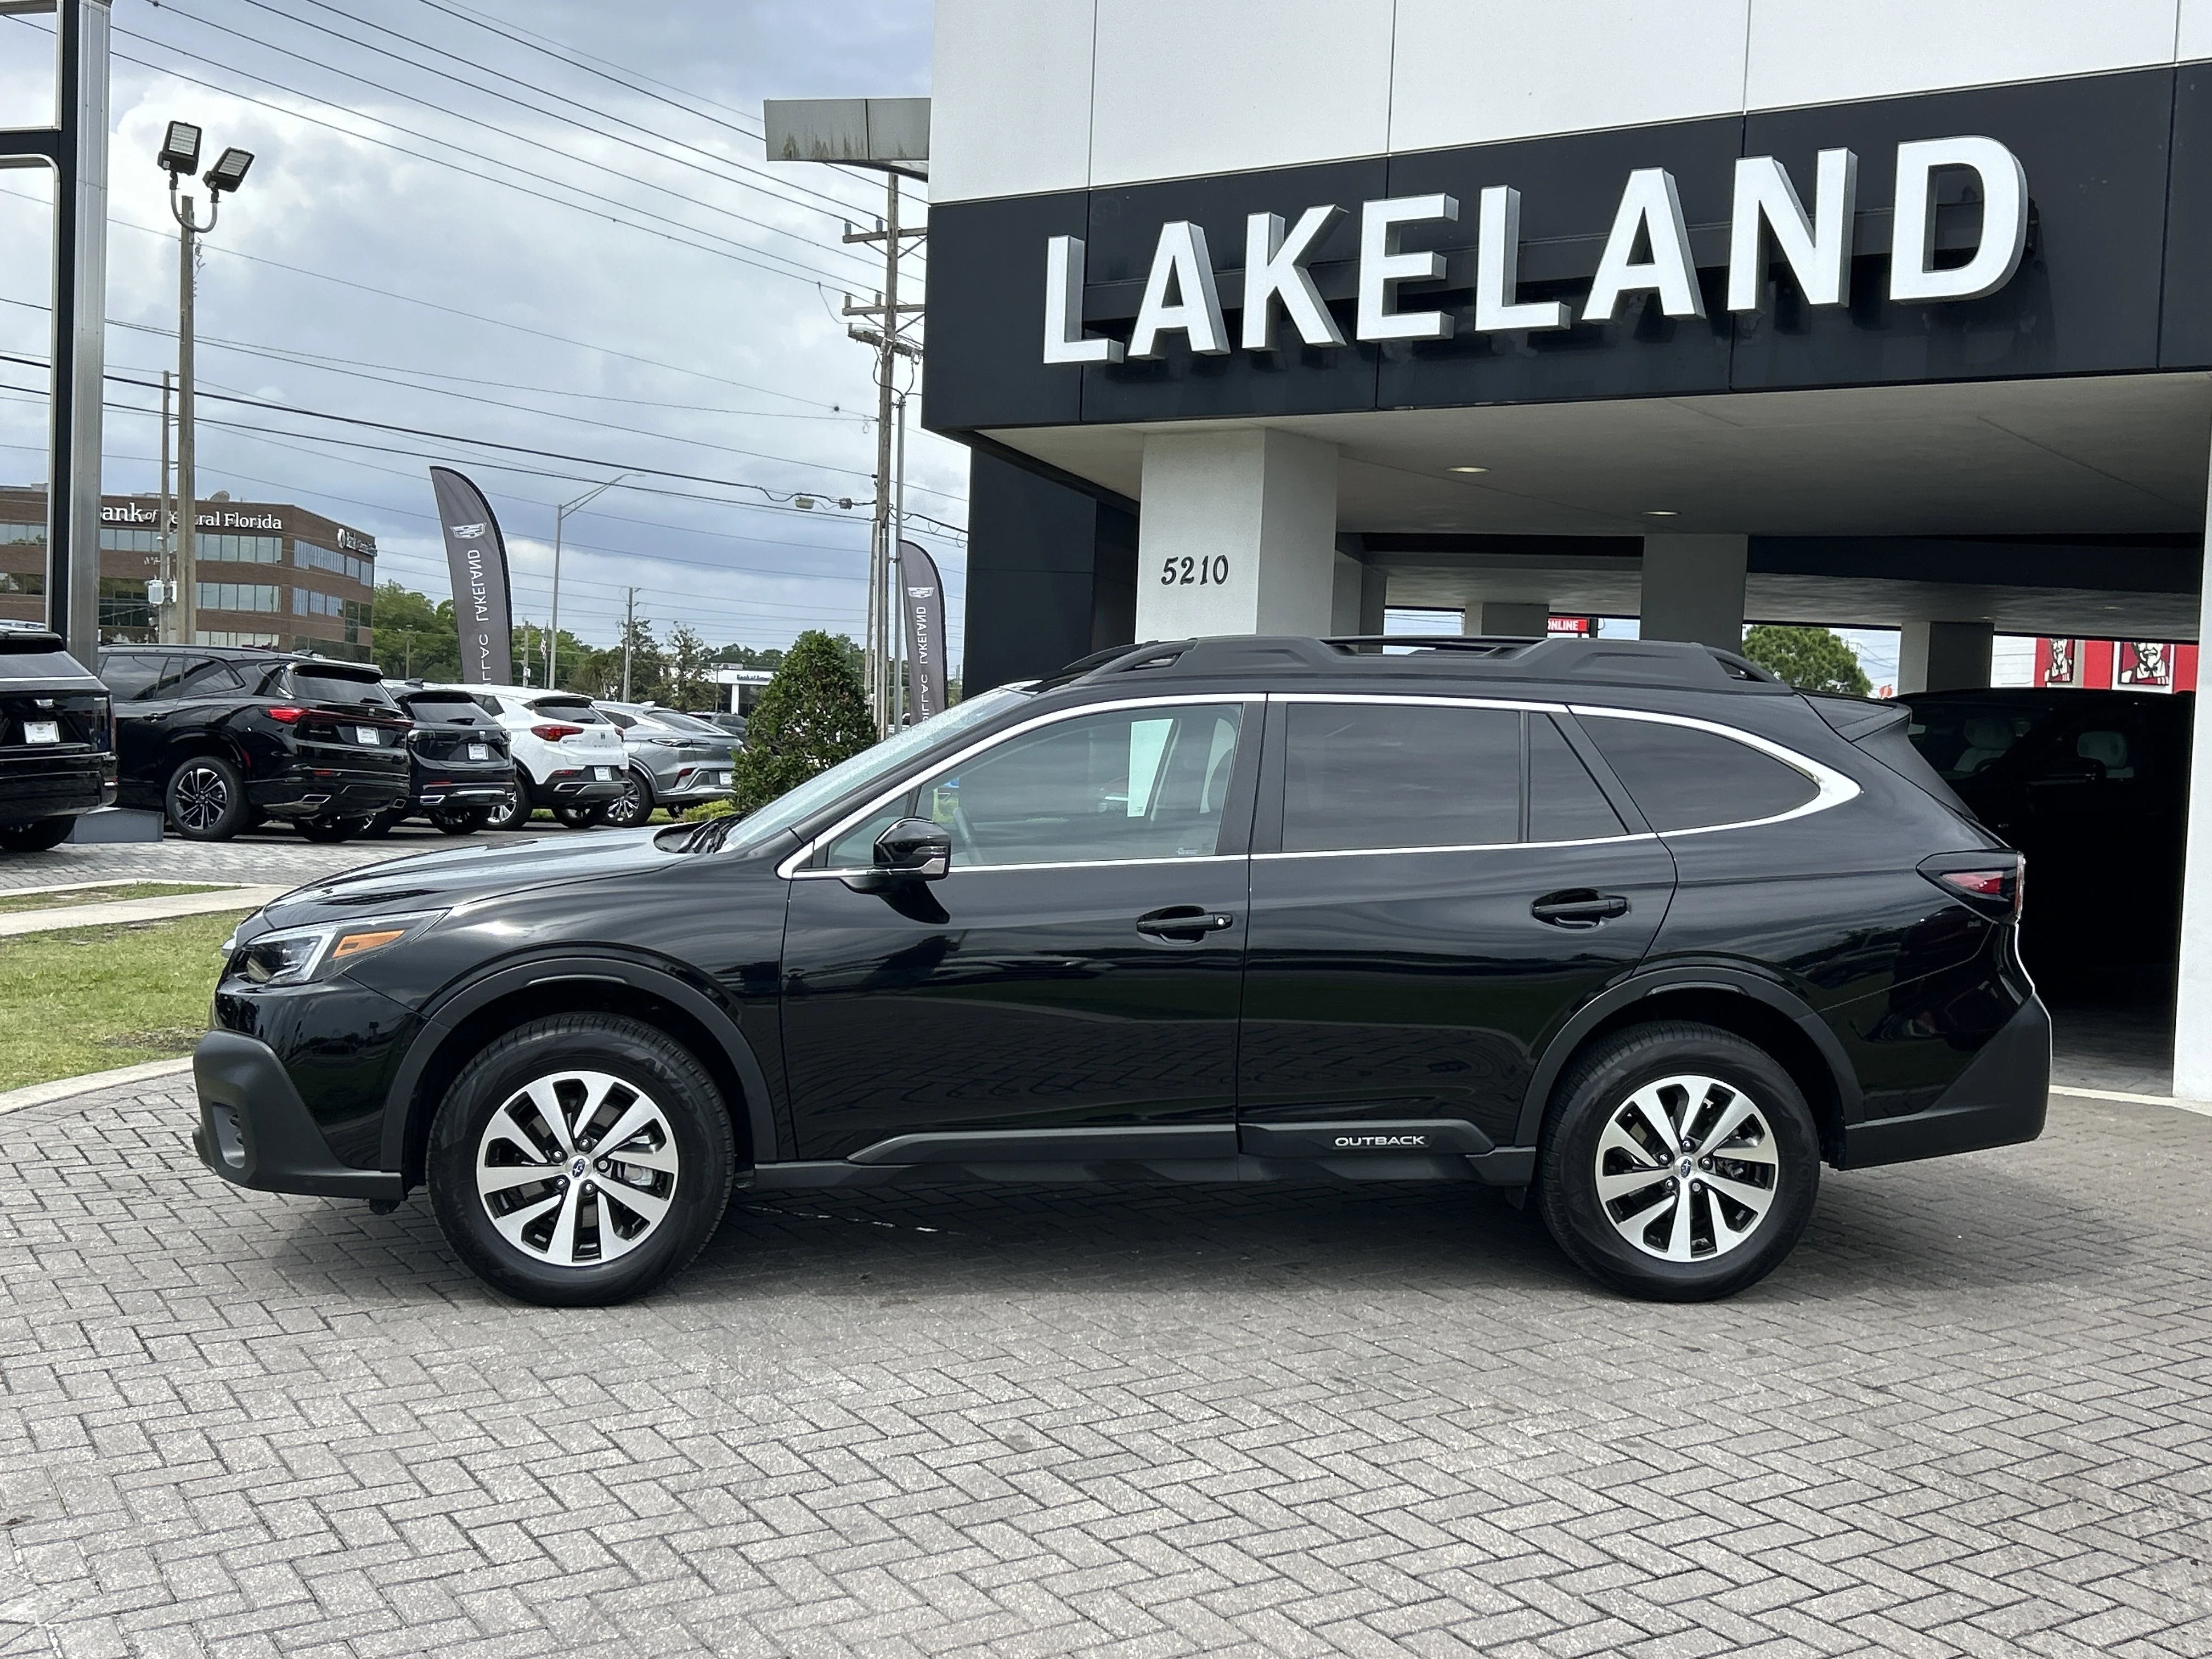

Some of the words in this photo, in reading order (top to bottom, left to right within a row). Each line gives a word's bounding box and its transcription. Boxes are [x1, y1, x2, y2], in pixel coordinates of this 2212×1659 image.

[1043, 136, 2028, 364] LAKELAND
[101, 503, 144, 522] ank
[145, 509, 159, 523] of
[224, 512, 283, 529] Florida
[1161, 555, 1228, 585] 5210
[1335, 1136, 1425, 1147] OUTBACK
